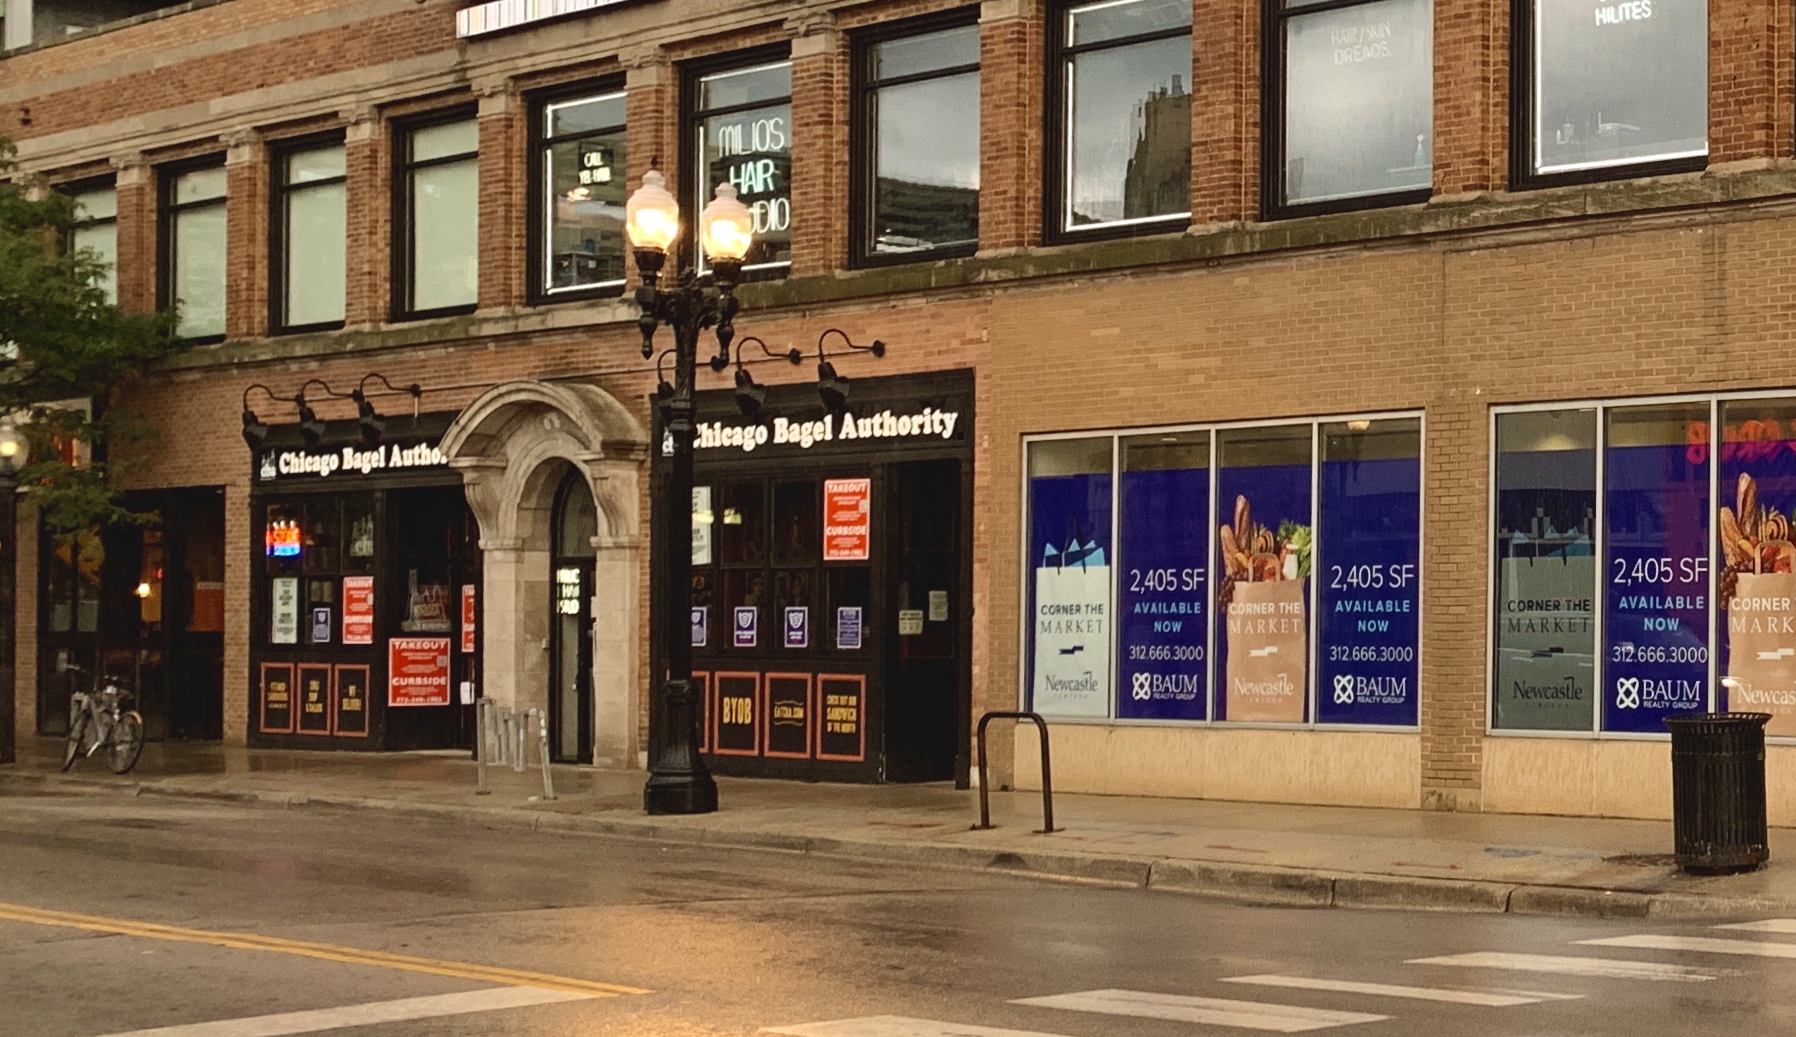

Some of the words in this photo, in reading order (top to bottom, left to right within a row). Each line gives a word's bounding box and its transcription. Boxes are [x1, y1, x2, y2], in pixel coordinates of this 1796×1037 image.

[1595, 0, 1652, 26] HILITES
[729, 159, 774, 195] HAIR
[773, 414, 833, 449] Bagel
[838, 407, 958, 440] Authority
[279, 450, 339, 477] Chicago
[342, 444, 386, 474] Bagel
[389, 441, 447, 467] Autho
[828, 482, 867, 494] TAKEOUT
[1330, 565, 1384, 592] 2,405
[1388, 564, 1415, 588] SF
[1613, 557, 1674, 586] 2,405
[1679, 557, 1708, 583] SF
[1129, 569, 1177, 594] 2,405
[1181, 568, 1205, 591] SF
[1040, 604, 1081, 615] CORNER
[1085, 603, 1104, 614] THE
[1134, 602, 1201, 614] AVAILABLE
[1229, 602, 1275, 614] CORNER
[1278, 602, 1301, 614] THE
[1335, 600, 1410, 613] AVAILABLE
[1507, 599, 1561, 612] CORNER
[1564, 599, 1591, 612] THE
[1619, 596, 1705, 609] AVAILABLE
[1731, 597, 1790, 611] CORNER
[1040, 619, 1103, 634] MARKET
[1153, 620, 1182, 633] NOW
[1229, 618, 1300, 634] MARKET
[1357, 620, 1389, 632] NOW
[1507, 617, 1590, 633] MARKET
[1643, 617, 1680, 631] NOW
[394, 640, 446, 650] TAKEOUT
[1129, 645, 1204, 660] 312.666.3000
[1329, 645, 1413, 662] 312.666.3000
[1612, 645, 1708, 663] 312.666.3000
[392, 676, 446, 686] CURBSIDE
[1044, 671, 1098, 692] Newcastle
[1152, 673, 1198, 693] BAUM
[1234, 673, 1294, 696] Newcastle
[1356, 676, 1407, 696] BAUM
[1513, 676, 1583, 700] Newcastle
[1642, 679, 1700, 701] BAUM
[1382, 696, 1405, 704] GROUP
[1643, 701, 1670, 709] REALTY
[1672, 701, 1698, 709] GROUP
[722, 697, 752, 725] BYOB
